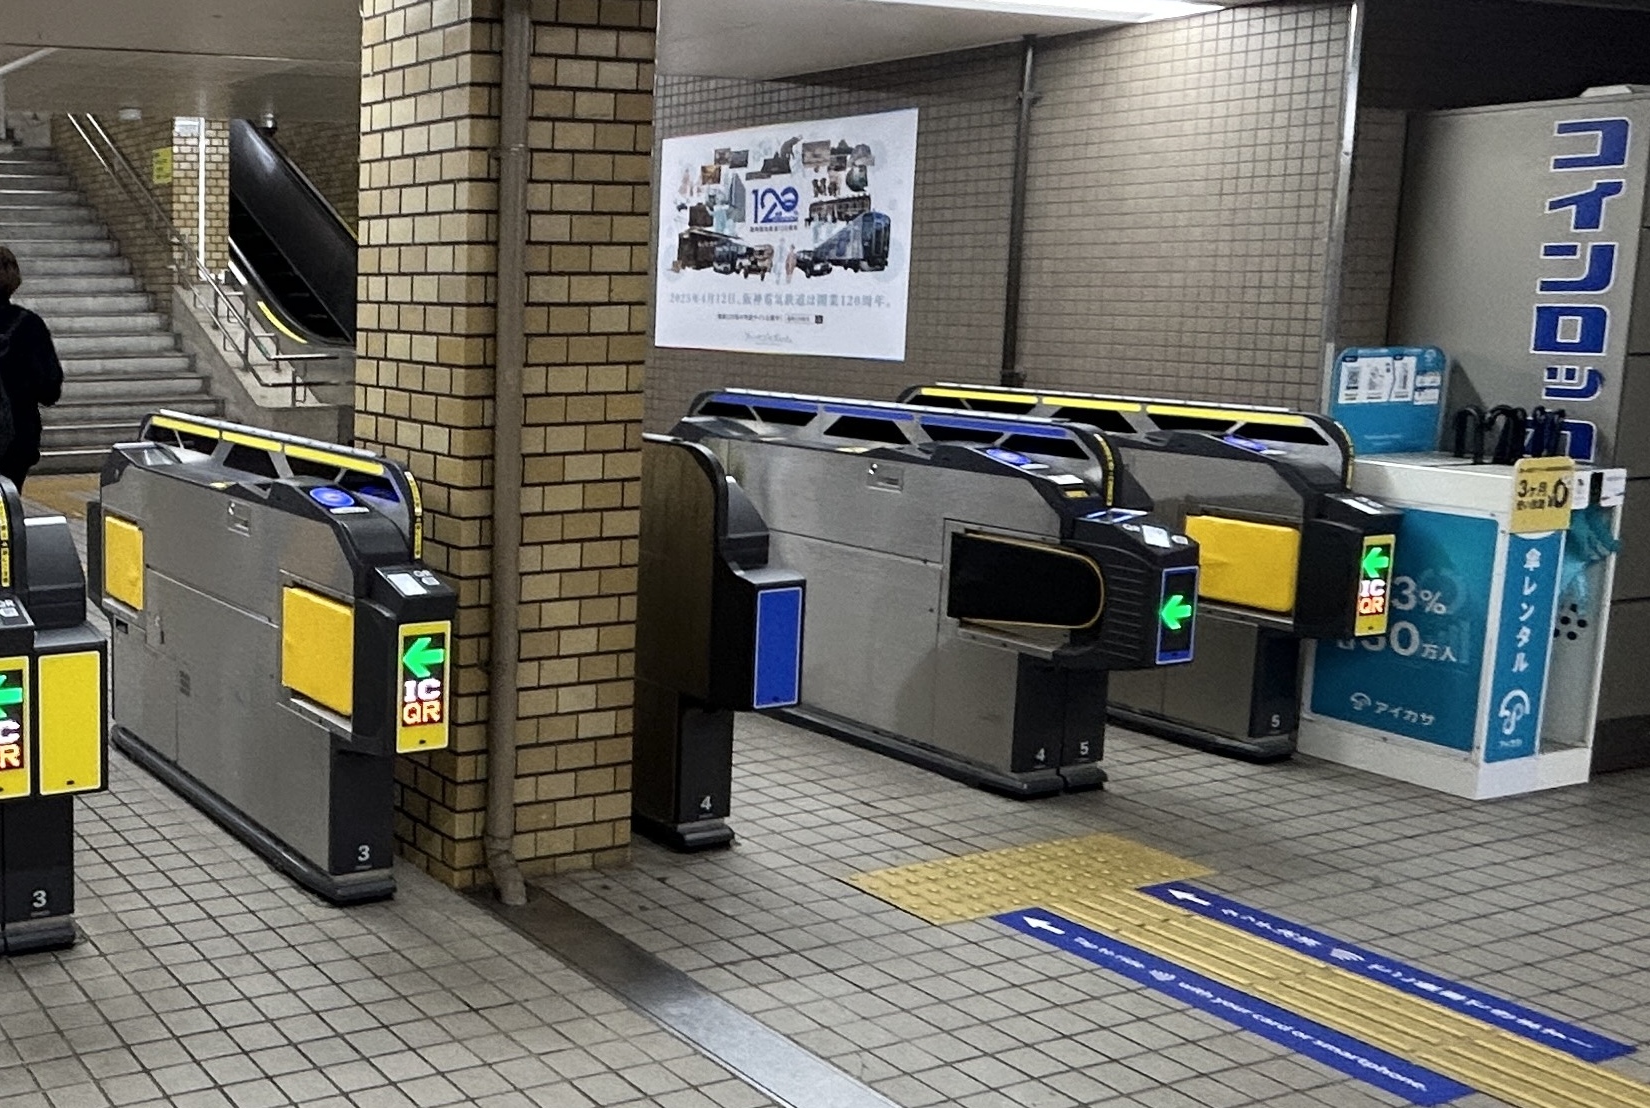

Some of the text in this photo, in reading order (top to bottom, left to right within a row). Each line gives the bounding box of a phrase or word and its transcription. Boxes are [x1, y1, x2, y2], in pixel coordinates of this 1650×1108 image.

[1359, 579, 1386, 598] IC
[1358, 597, 1385, 614] QR
[403, 678, 441, 702] IC
[403, 701, 442, 725] QR
[1270, 714, 1281, 728] 5
[1375, 700, 1436, 727] アイカサ
[1035, 747, 1045, 761] 4
[1080, 741, 1089, 755] 5
[699, 794, 712, 811] 4
[357, 844, 371, 863] 3
[32, 889, 48, 908] 3
[1073, 936, 1098, 950] Tap
[1114, 953, 1146, 969] ride
[1178, 981, 1213, 999] with
[1210, 995, 1254, 1016] your
[1252, 1011, 1294, 1033] card
